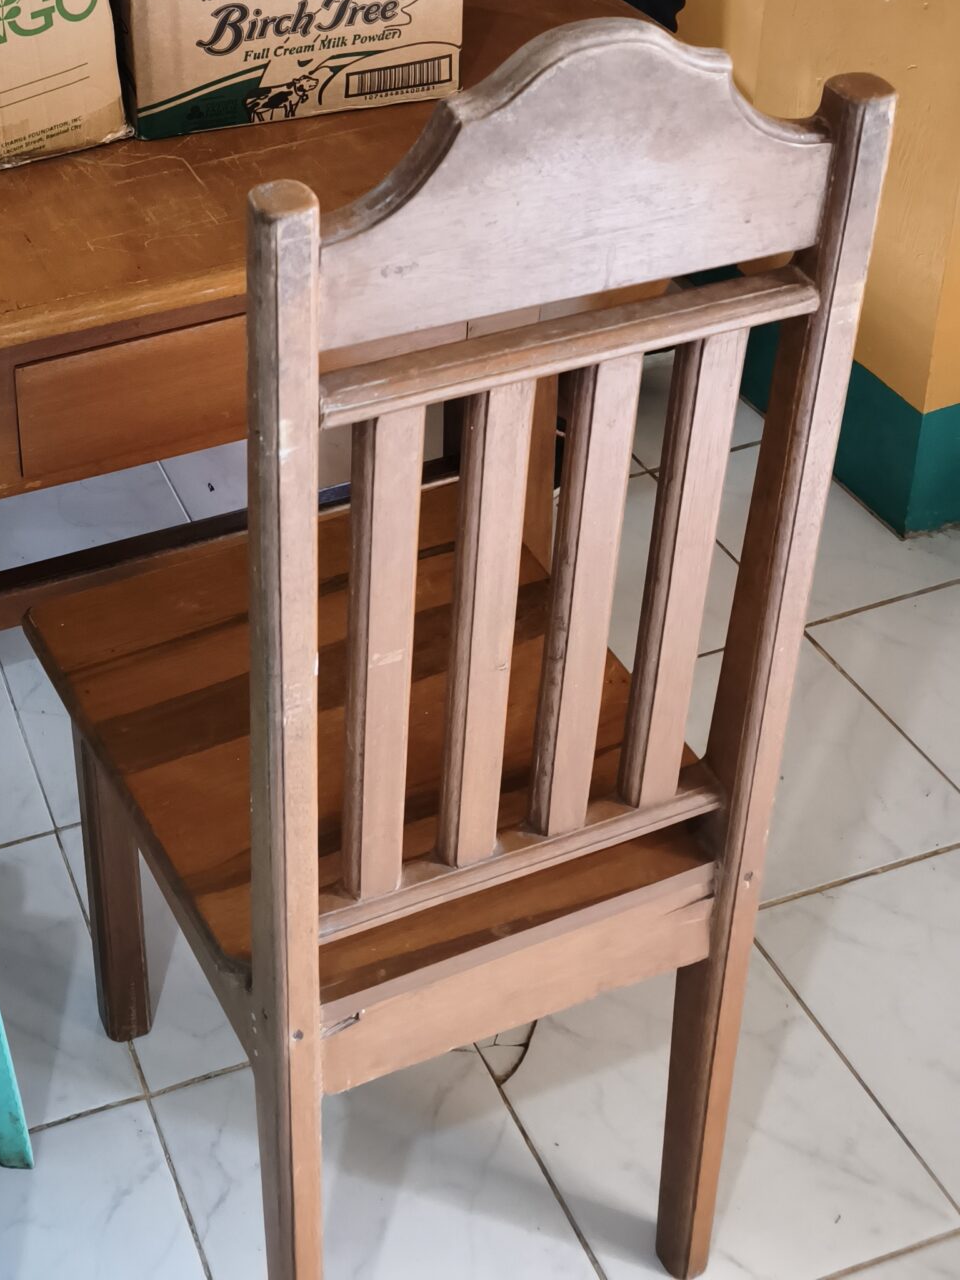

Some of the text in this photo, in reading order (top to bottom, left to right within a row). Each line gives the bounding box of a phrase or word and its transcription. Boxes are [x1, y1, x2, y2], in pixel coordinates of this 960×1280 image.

[243, 29, 398, 63] Full Cream Milk Powder
[1, 136, 26, 147] CHANGE
[28, 121, 71, 138] FOUNDATION,
